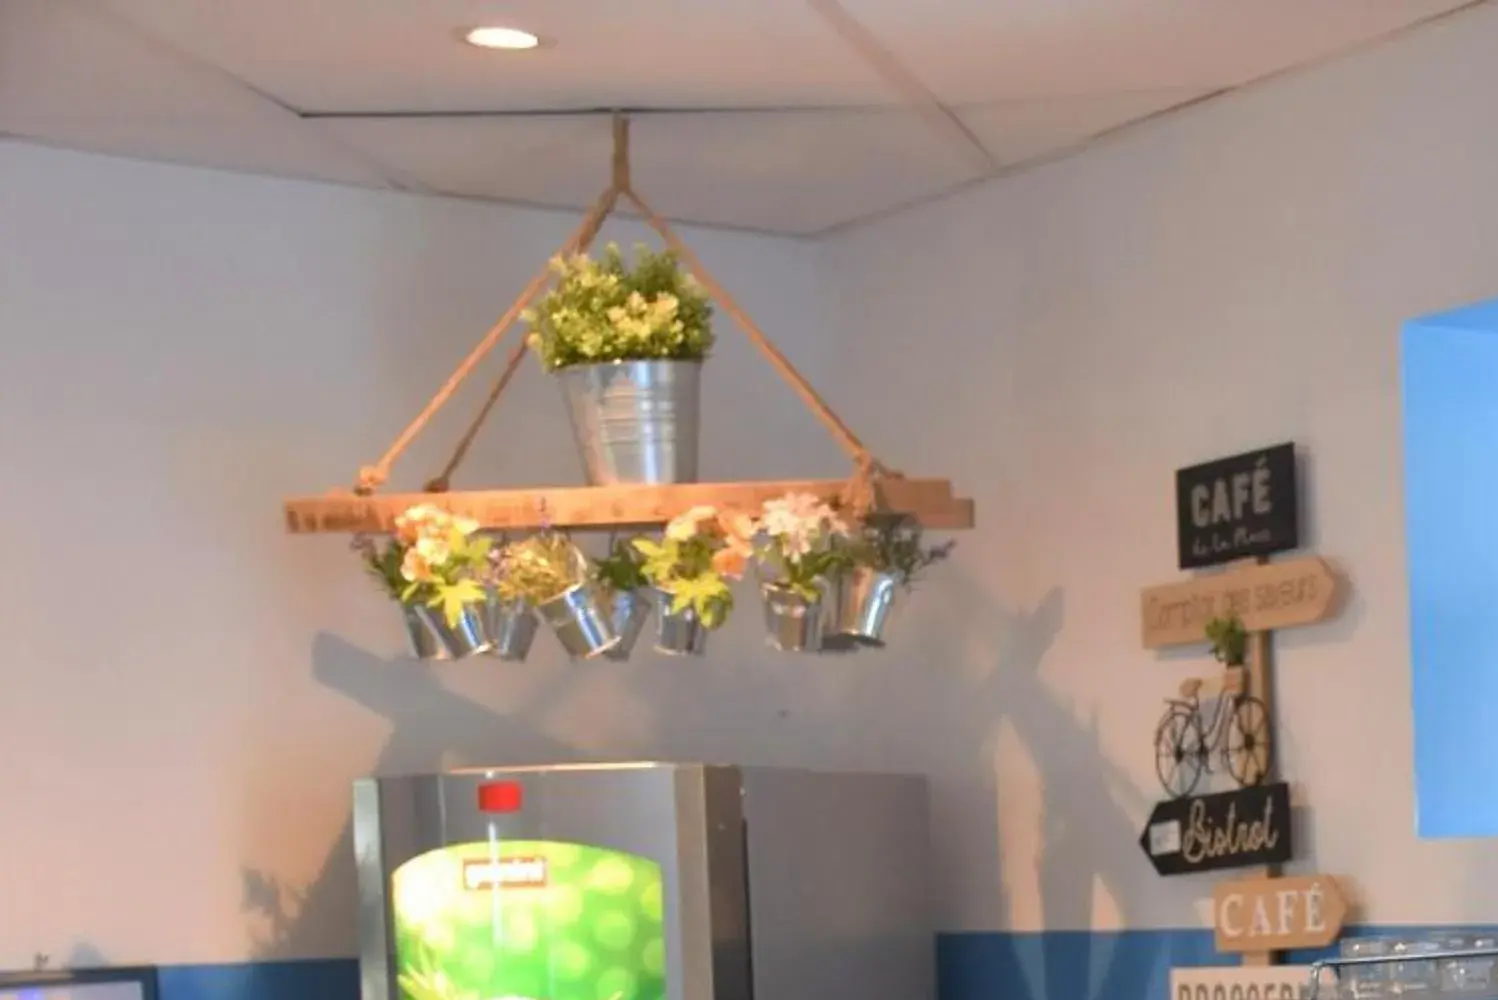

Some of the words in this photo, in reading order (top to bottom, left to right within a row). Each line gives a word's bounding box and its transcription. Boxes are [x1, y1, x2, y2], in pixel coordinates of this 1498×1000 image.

[1190, 454, 1273, 528] CAFÉ
[1182, 795, 1280, 864] Bistrot
[1219, 881, 1327, 939] CAFÉ
